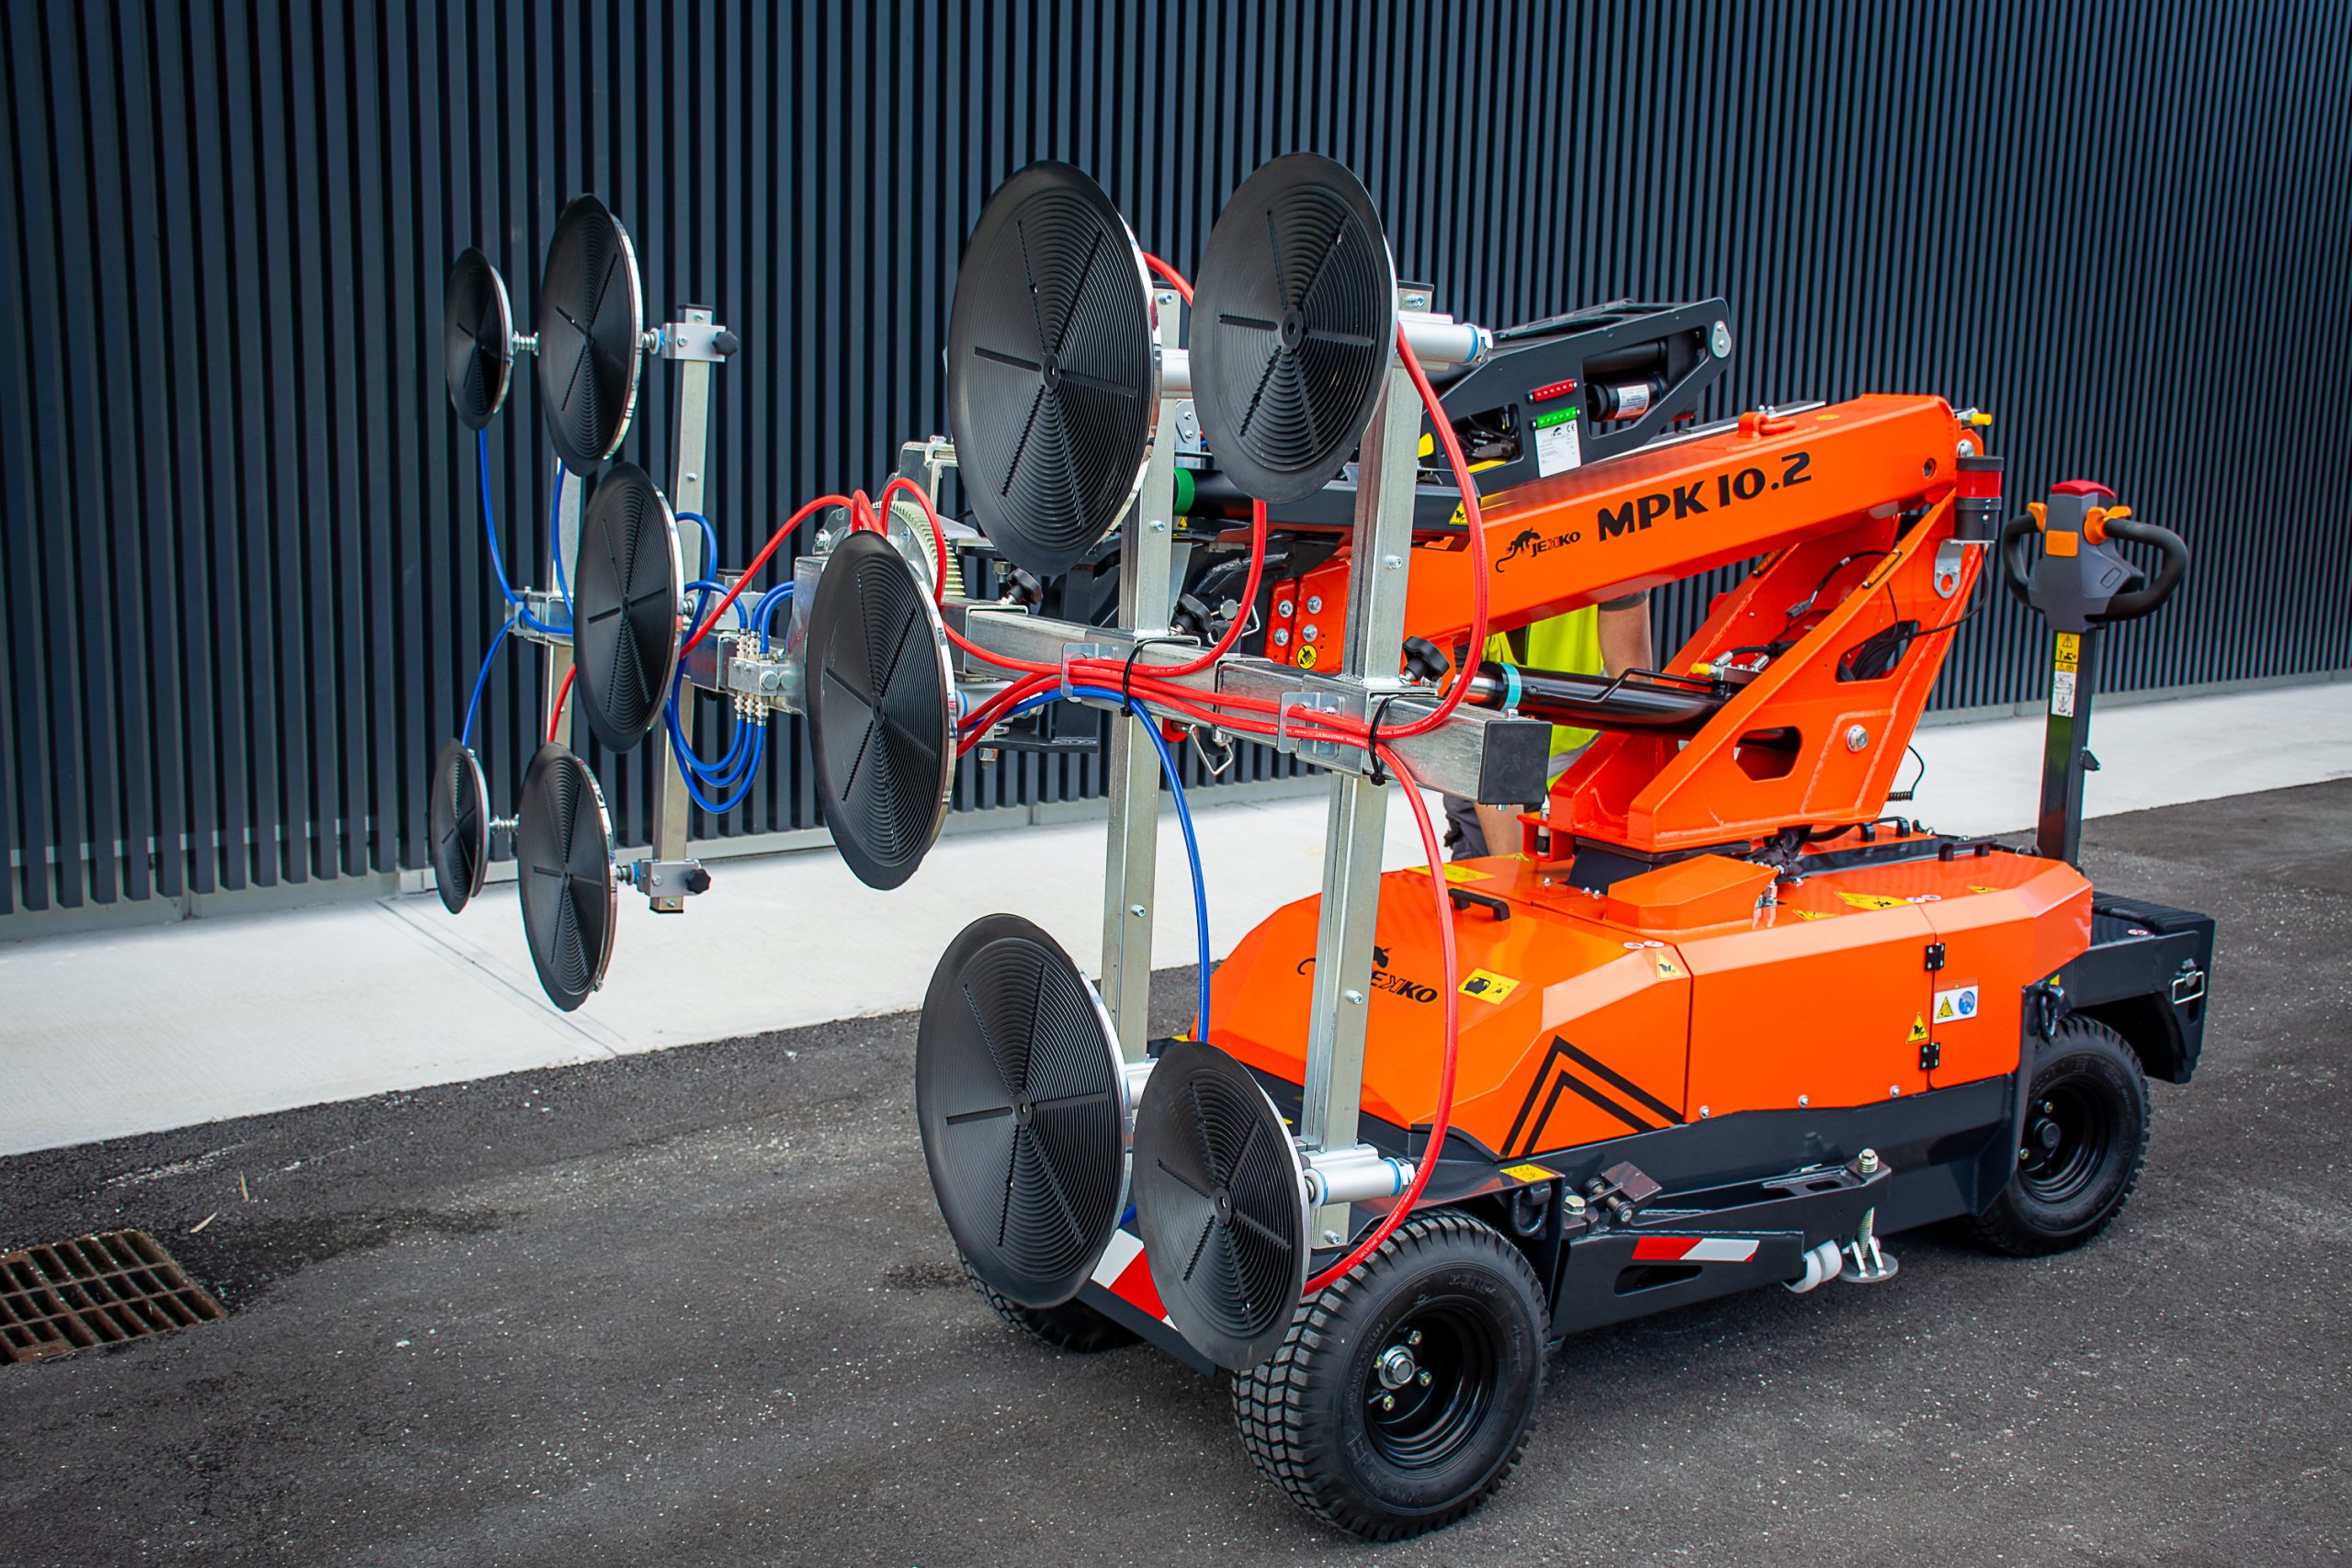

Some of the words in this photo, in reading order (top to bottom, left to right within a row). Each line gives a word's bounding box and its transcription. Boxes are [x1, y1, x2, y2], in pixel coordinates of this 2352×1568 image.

[1597, 480, 1709, 542] MPK
[1717, 451, 1812, 507] 10.2
[1531, 531, 1581, 558] JEKKO
[1371, 970, 1438, 1003] EKKO
